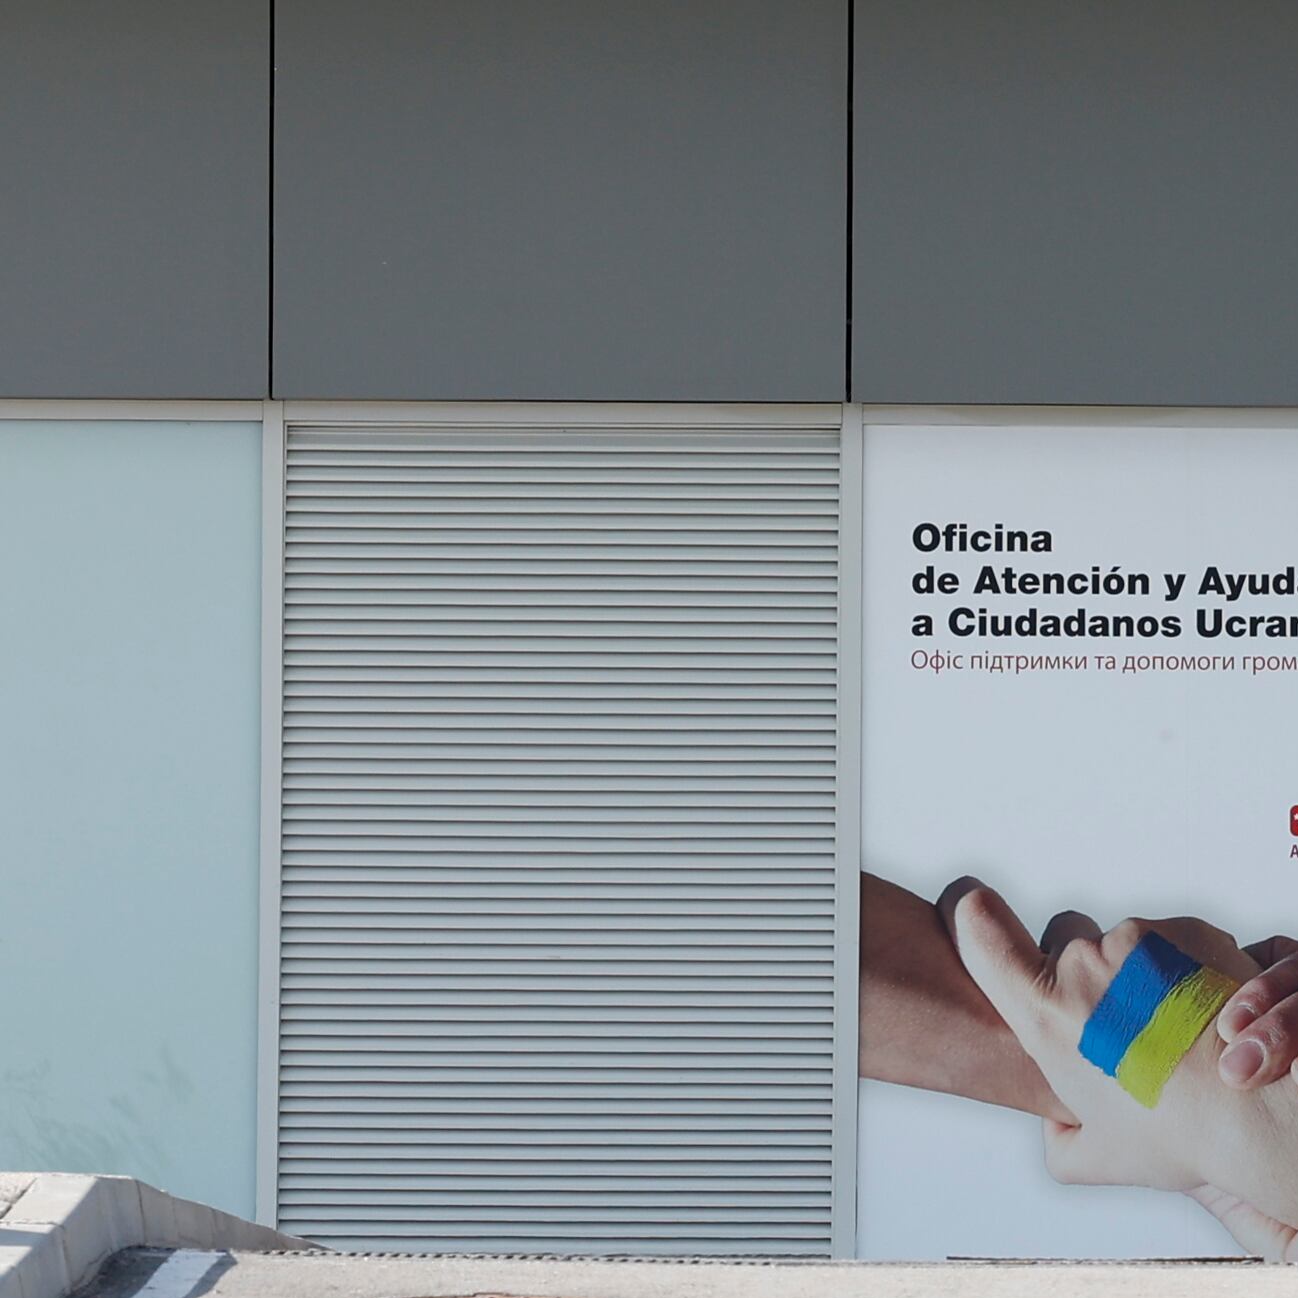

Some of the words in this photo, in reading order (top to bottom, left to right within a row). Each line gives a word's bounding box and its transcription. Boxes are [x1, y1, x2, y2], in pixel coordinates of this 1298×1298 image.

[912, 523, 1053, 553] Oficina
[911, 566, 960, 595] de
[973, 565, 1150, 596] Atención
[1164, 574, 1187, 602] y
[911, 614, 934, 637] a
[948, 608, 1182, 638] Ciudadanos
[910, 649, 963, 674] Офіс
[970, 650, 1087, 674] підтримки
[1093, 656, 1116, 671] та
[1122, 656, 1235, 674] допомоги
